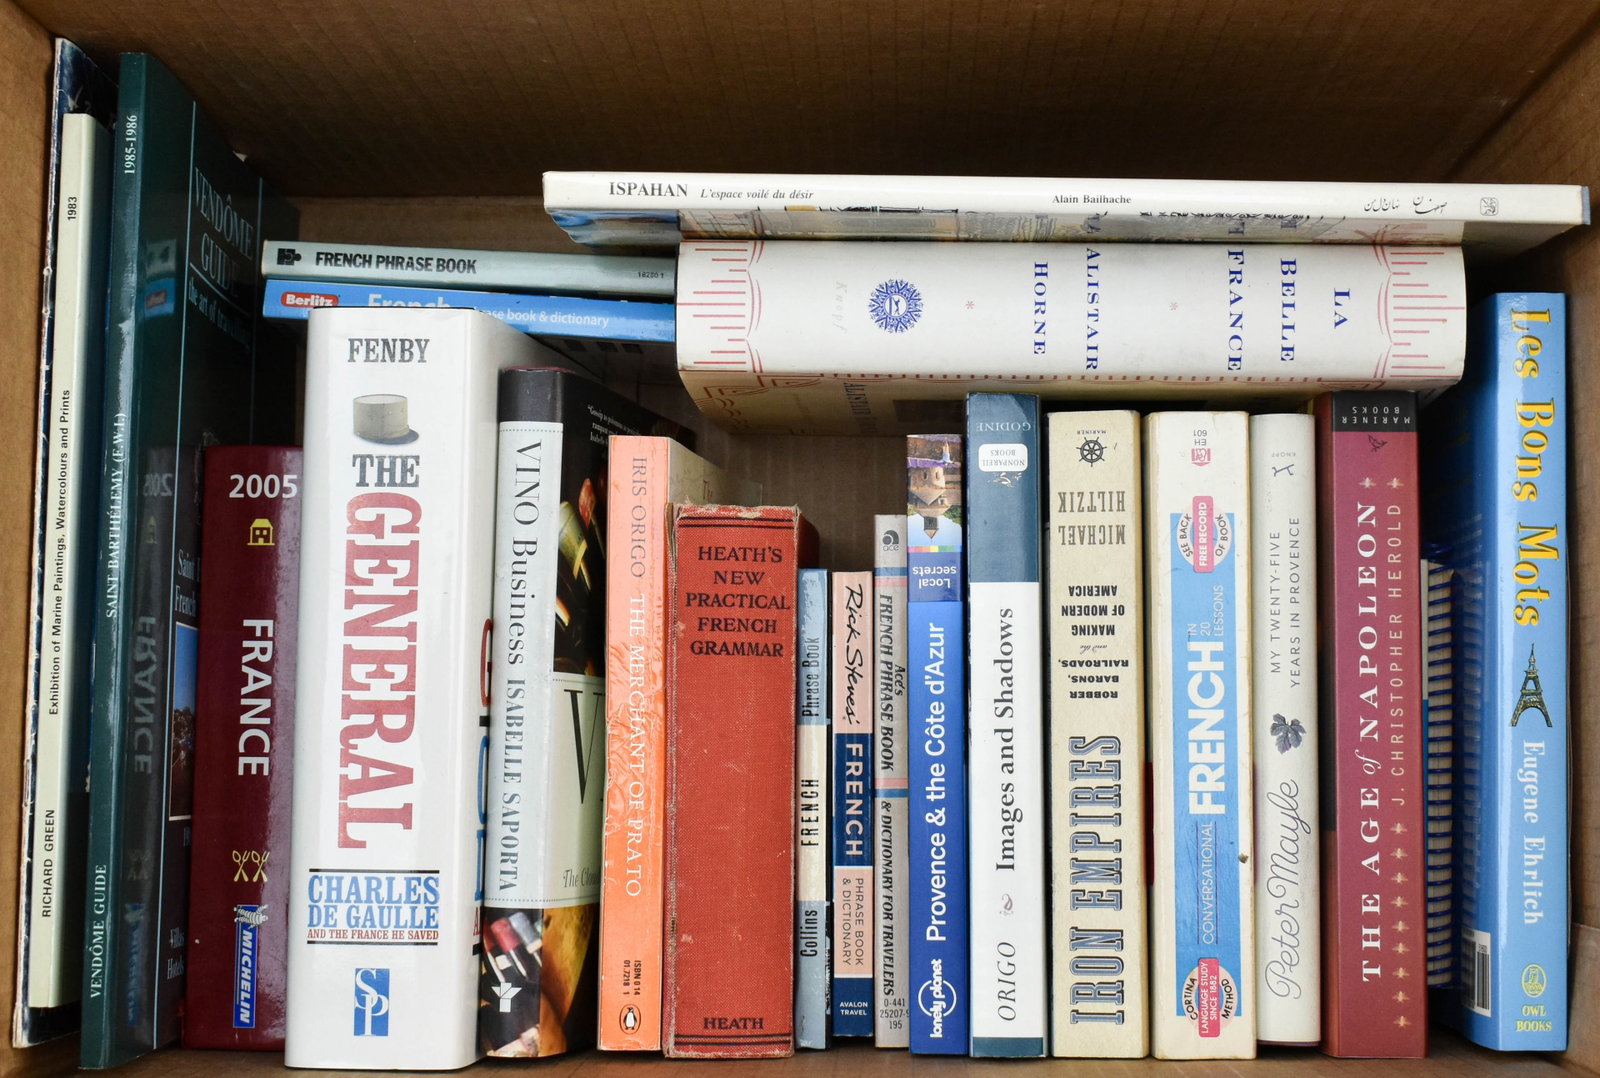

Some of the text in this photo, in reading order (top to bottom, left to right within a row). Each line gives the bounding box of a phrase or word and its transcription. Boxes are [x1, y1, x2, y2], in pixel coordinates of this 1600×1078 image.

[124, 115, 138, 174] 1985-1986
[67, 195, 78, 221] 1983
[609, 181, 815, 200] ISPAHAN L'espace voilé du désir
[1052, 194, 1132, 204] Alain Bailhache
[195, 167, 254, 261] VENDÔME
[315, 252, 477, 274] FRENCH PHRASE BOOK
[286, 293, 333, 307] Berlitz
[507, 308, 536, 321] book
[539, 312, 551, 321] &
[550, 311, 610, 329] dictionary
[1033, 261, 1049, 355] HORNE
[1086, 247, 1101, 371] ALISTAIR
[1227, 249, 1245, 371] FRANCE
[1280, 258, 1297, 361] BELLE
[1334, 287, 1350, 328] LA
[347, 337, 430, 363] FENBY
[976, 421, 1032, 432] GODINE
[1342, 416, 1410, 425] MARINER
[1351, 405, 1400, 414] BOOKS
[1193, 429, 1208, 437] 601
[228, 473, 298, 498] 2005
[352, 453, 420, 488] THE
[1511, 308, 1560, 627] Les Bons Mots
[106, 467, 123, 570] BARTHÉLEMY
[1058, 491, 1127, 513] HILTZIK
[48, 389, 70, 715] Exhibition of Marine Paintings, Watercolours and Prints
[508, 439, 542, 665] VINO Business
[698, 545, 783, 563] HEATH'S
[1058, 524, 1127, 546] MICHAEL
[1198, 502, 1208, 567] FREE RECORD
[713, 570, 766, 585] NEW
[912, 565, 957, 575] secrets
[918, 578, 951, 589] Local
[1068, 585, 1118, 597] AMERICA
[106, 574, 119, 618] SAINT
[685, 592, 790, 610] PRACTICAL
[845, 583, 863, 644] Rick
[1061, 605, 1125, 617] OF MODERN
[1213, 585, 1224, 637] LESSONS
[1269, 530, 1281, 673] MY TWENTY-FIVE
[1289, 517, 1301, 688] YEARS IN PROVENCE
[697, 617, 777, 633] FRENCH
[1071, 624, 1116, 636] MAKING
[1187, 623, 1198, 637] IN
[1200, 622, 1211, 636] 20
[338, 492, 423, 849] GENERAL
[690, 640, 784, 657] GRAMMAR
[1058, 659, 1129, 668] RAILROADS,
[1387, 504, 1405, 805] J. CHRISTOPHER HEROLD
[237, 619, 275, 776] FRANCE
[626, 457, 647, 897] IRIS ORIGO THE MERCHANT OF PRATO
[802, 637, 820, 718] Phrase Book
[879, 594, 894, 772] FRENCH PHRASE BOOK
[1067, 675, 1119, 684] BARONS,
[1069, 691, 1119, 699] ROBBER
[1187, 641, 1226, 815] FRENCH
[1355, 501, 1382, 982] THE AGE of NAPOLEON
[499, 678, 526, 892] ISABELLE SAPORTA
[845, 743, 863, 856] FRENCH
[924, 622, 946, 941] Provence & the Côte d'Azur
[801, 778, 820, 847] FRENCH
[994, 607, 1024, 1022] ORIGO Images and Shadows
[1517, 740, 1546, 925] Eugene Ehrlich
[42, 809, 55, 918] RICHARD GREEN
[1068, 735, 1125, 1025] IRON EMPIRES
[1202, 820, 1216, 945] CONVERSATIONAL
[308, 874, 440, 905] CHARLES
[880, 801, 895, 996] & DICTIONARY FOR TRAVELERS
[1265, 779, 1312, 1000] Peter Mayle
[86, 863, 107, 999] VENDÔME GUIDE
[307, 904, 439, 929] DE GAULLE
[307, 928, 439, 940] AND THE FRANCE HE SAVED
[800, 909, 818, 957] Collins
[842, 877, 852, 966] & DICTIONARY
[855, 877, 864, 966] PHRASE BOOK
[240, 929, 253, 1024] MICHELIN
[633, 960, 642, 980] ISBN
[929, 958, 947, 1038] lonely planet
[1183, 977, 1198, 1021] CORTINA
[1200, 961, 1209, 1034] LANGUAGE STUDY
[1209, 996, 1218, 1020] SINCE
[1221, 978, 1234, 1019] METHOD
[1521, 1004, 1547, 1017] OWL
[703, 1017, 764, 1030] HEATH
[889, 1019, 903, 1030] 195
[1515, 1019, 1552, 1032] BOOKS
